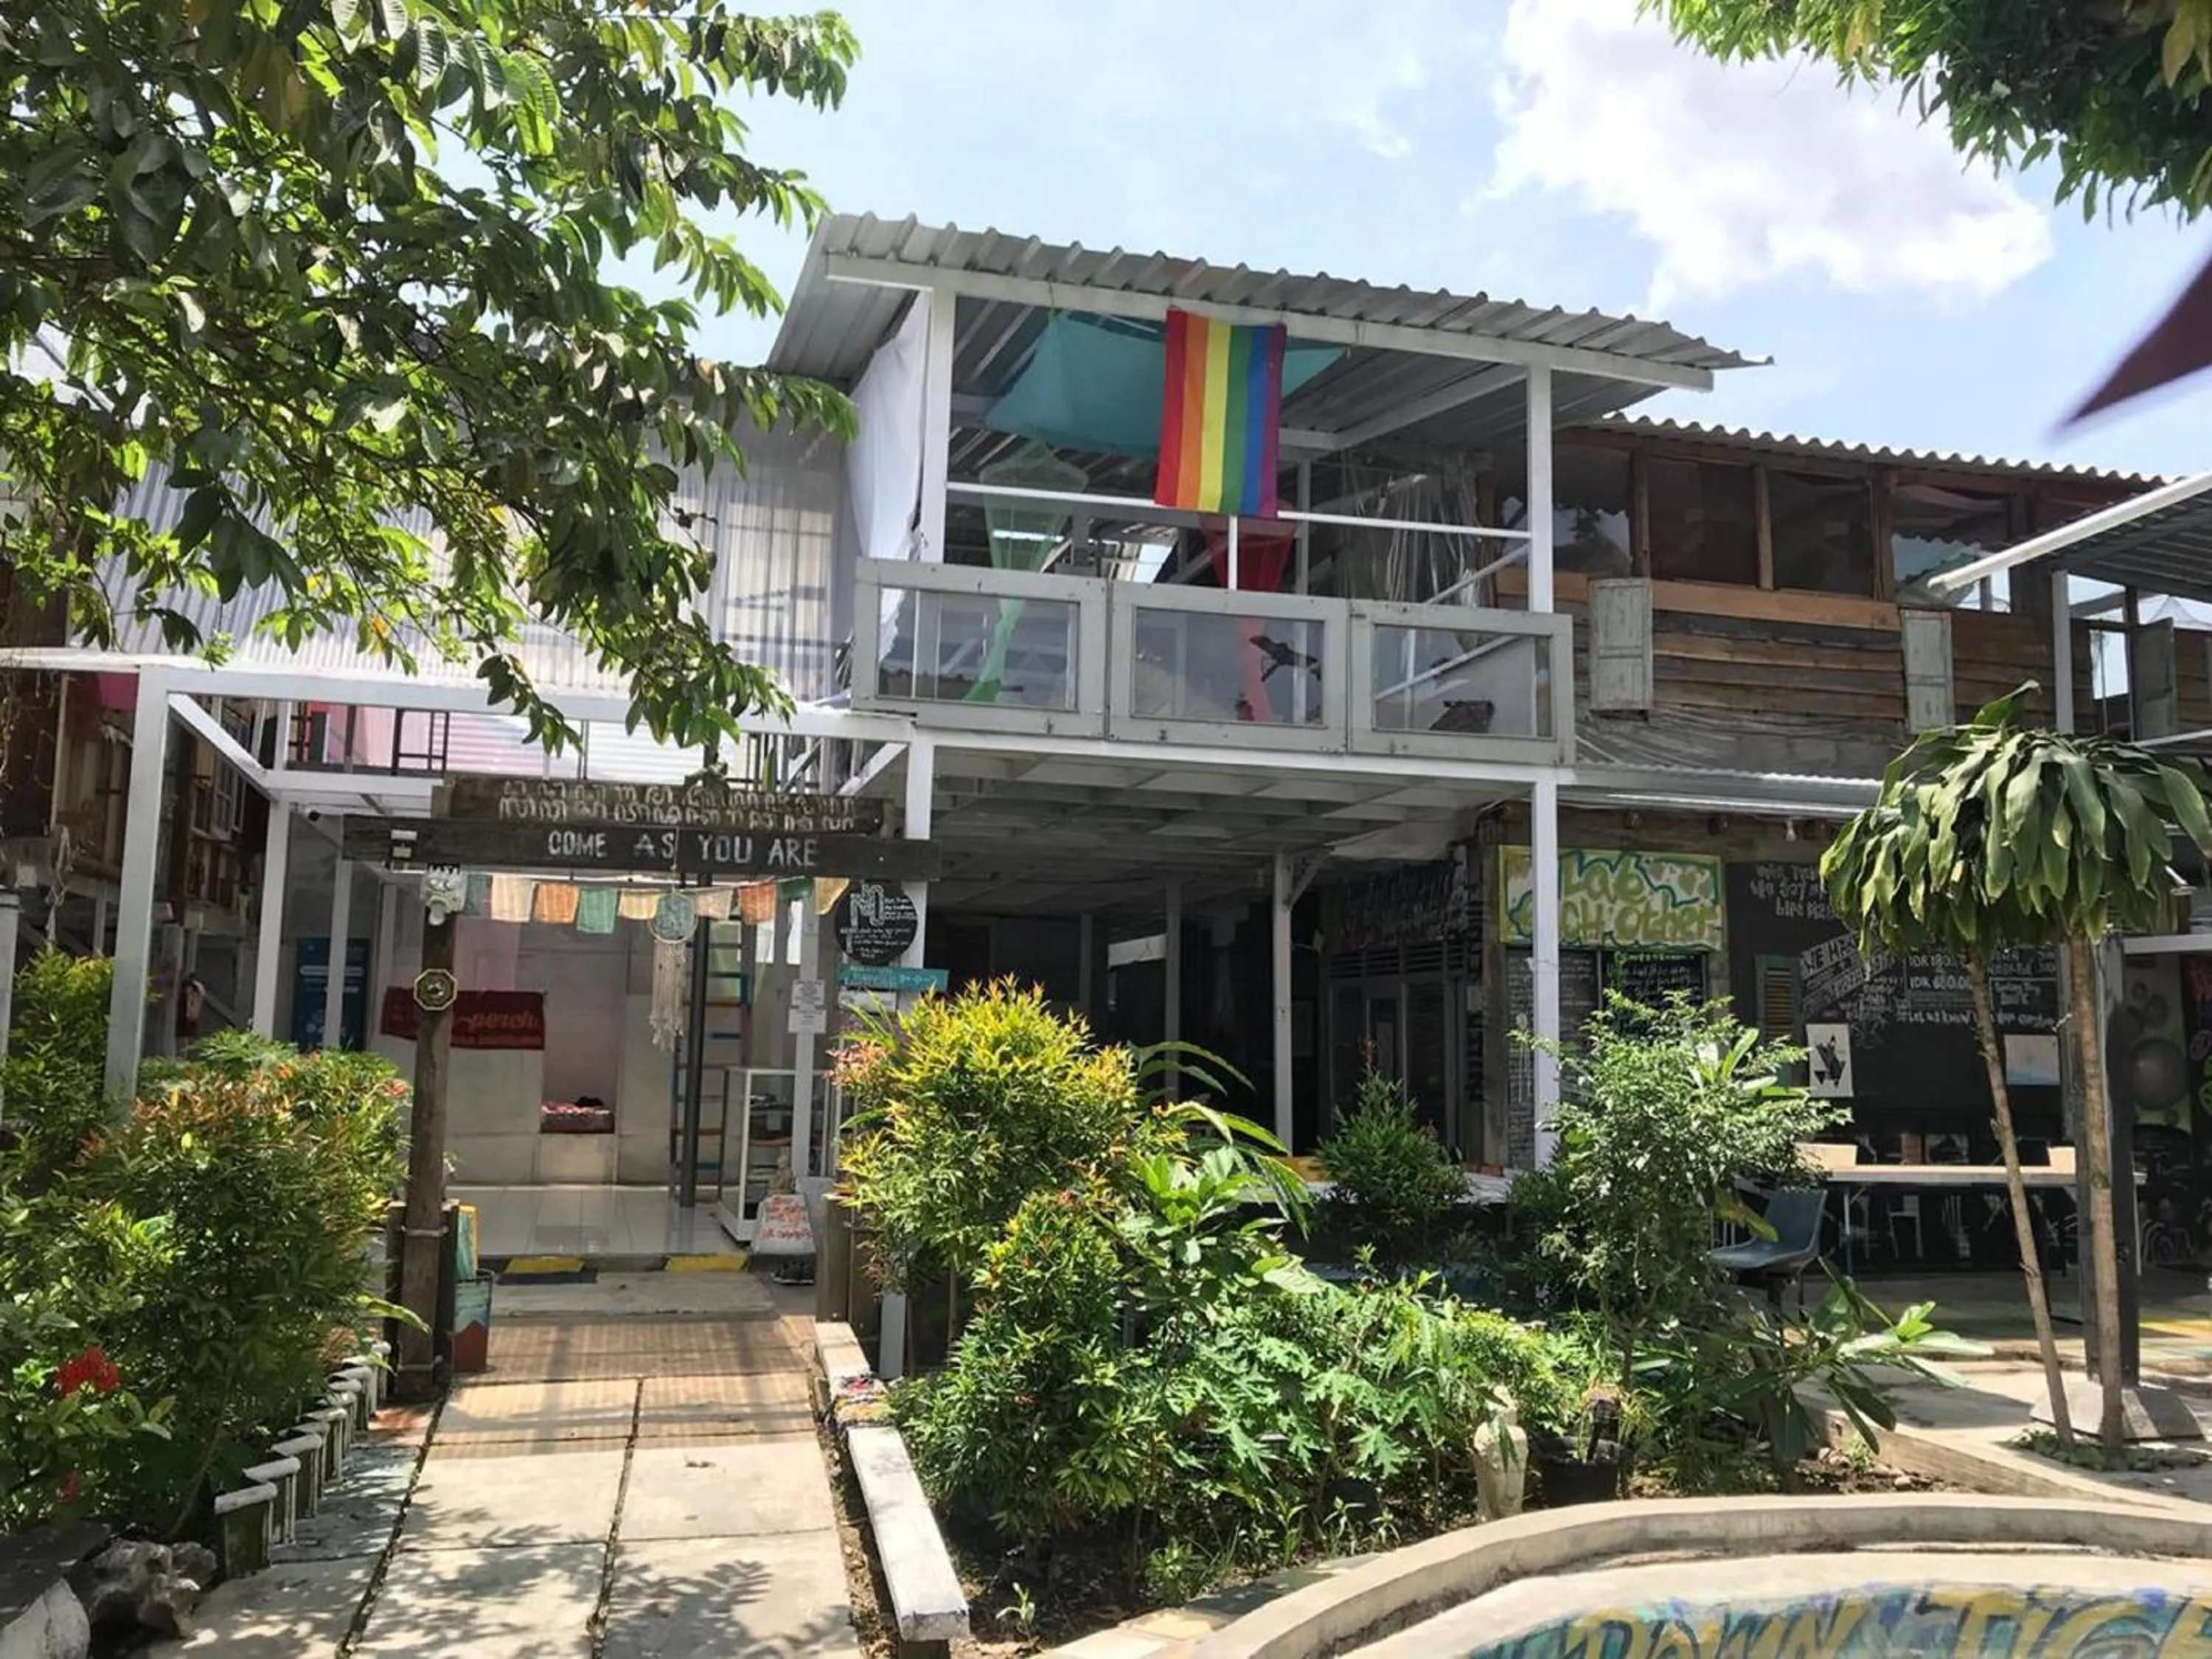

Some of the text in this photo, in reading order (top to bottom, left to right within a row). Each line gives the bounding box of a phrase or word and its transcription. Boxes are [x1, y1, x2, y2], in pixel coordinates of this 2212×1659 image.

[548, 830, 819, 868] COME AS YOU ARE
